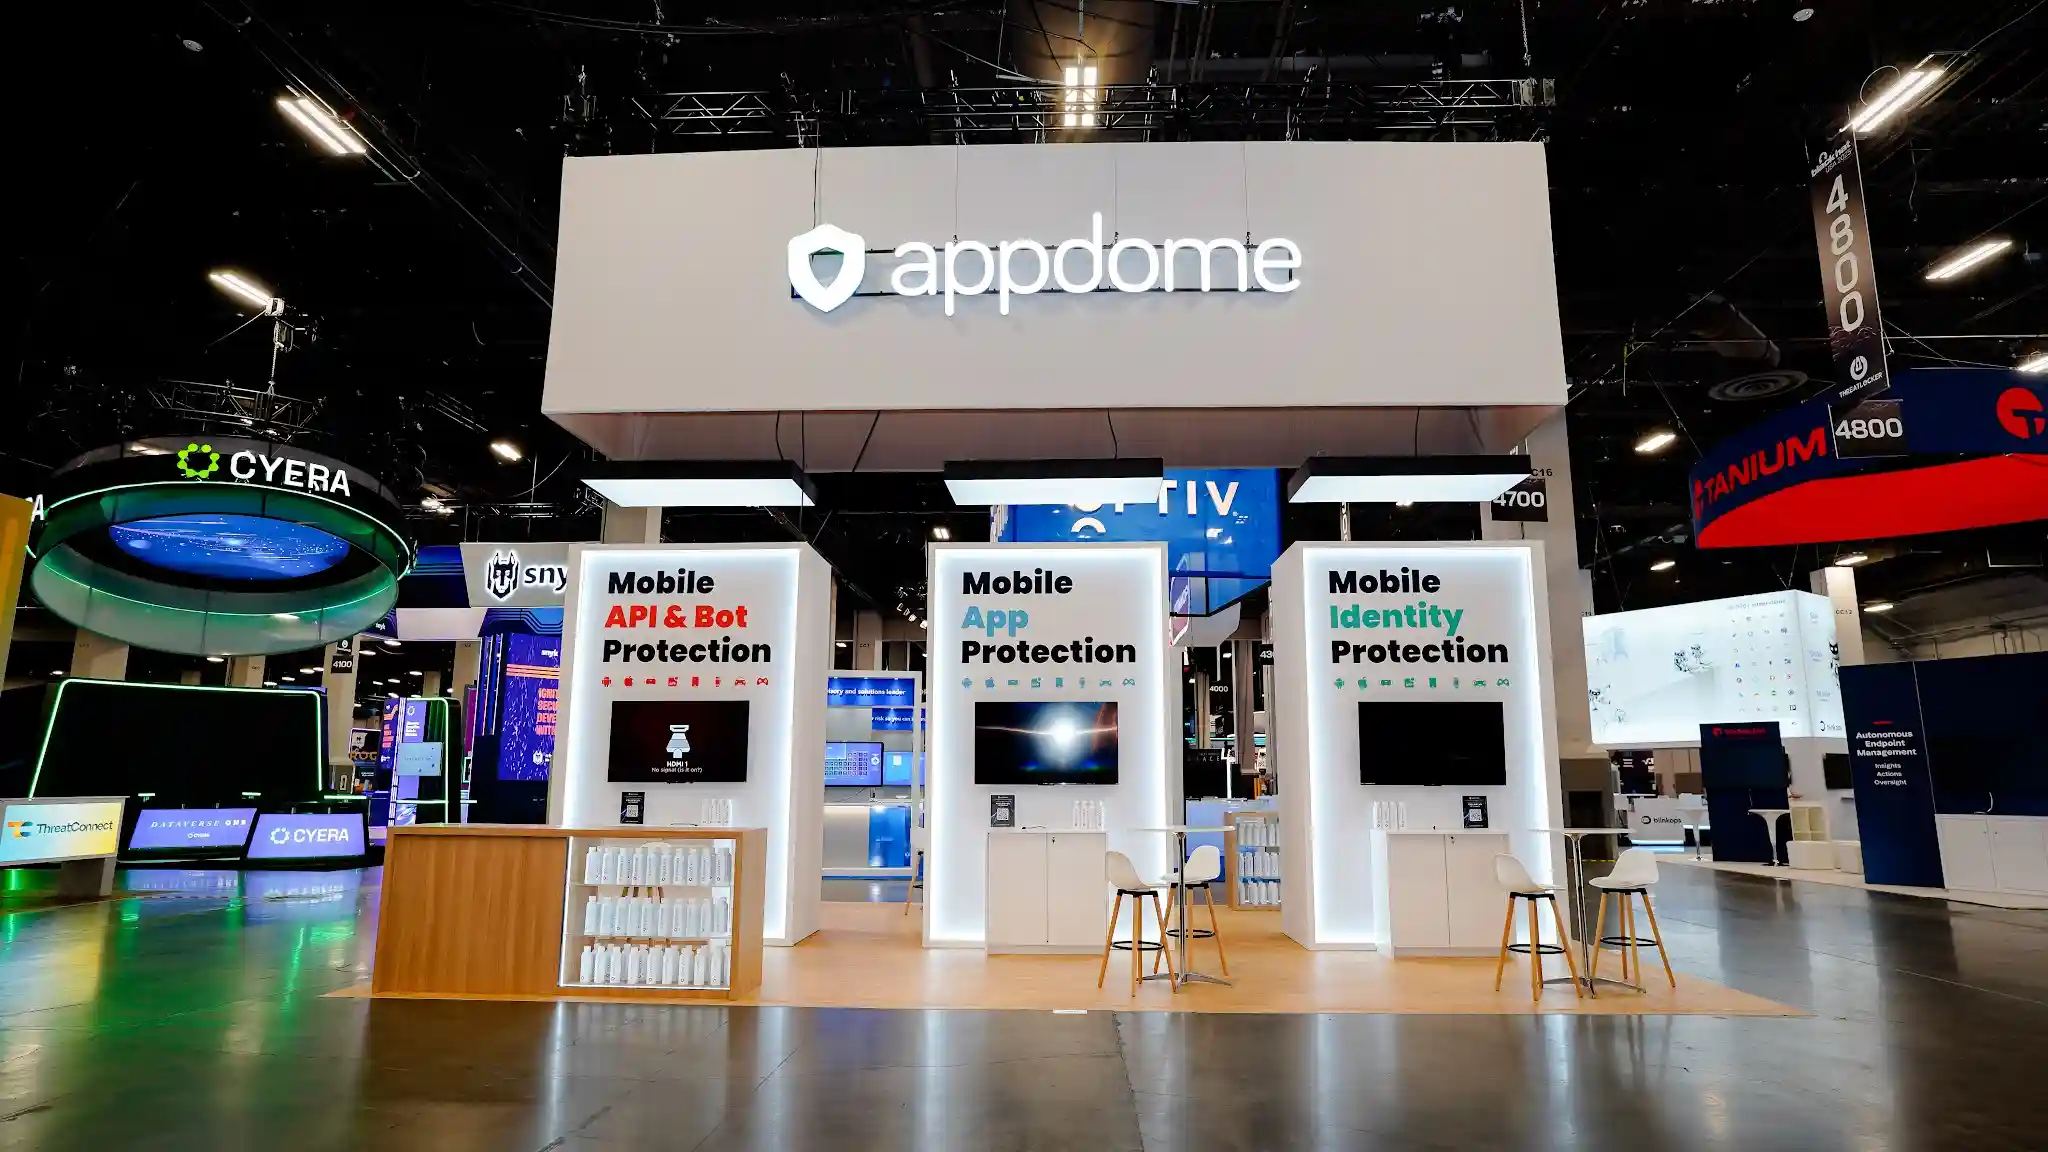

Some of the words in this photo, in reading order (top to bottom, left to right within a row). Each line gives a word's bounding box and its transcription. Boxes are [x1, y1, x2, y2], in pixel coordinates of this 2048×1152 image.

[1811, 154, 1835, 177] black
[1835, 140, 1851, 158] hat
[1825, 161, 1837, 173] USA
[891, 211, 1302, 316] appdome
[1826, 173, 1866, 333] 4800
[1839, 371, 1884, 398] THREATLOCKER
[1835, 417, 1903, 439] 4800
[230, 450, 351, 497] CYERA
[1531, 468, 1553, 477] C16
[1704, 427, 1827, 504] TANIUM
[1493, 491, 1545, 508] 4700
[523, 566, 568, 591] sny
[608, 567, 715, 594] Mobile
[962, 567, 1073, 594] Mobile
[1328, 566, 1441, 593] Mobile
[604, 605, 657, 628] API
[663, 605, 688, 628] &
[694, 605, 748, 628] Bot
[961, 605, 1029, 637] App
[1329, 601, 1464, 636] Identity
[541, 649, 559, 657] snyk
[602, 635, 772, 663] Protection
[961, 636, 1136, 663] Protection
[1260, 650, 1275, 658] 43
[1331, 635, 1509, 663] Protection
[333, 660, 353, 668] 4100
[1856, 731, 1914, 739] Autonomous
[1865, 739, 1906, 748] Endpoint
[1856, 748, 1917, 757] Management
[36, 820, 114, 834] ThreatConnect
[150, 820, 220, 828] DATAVERSE
[1653, 815, 1682, 824] blinkops
[293, 828, 349, 843] CYERA
